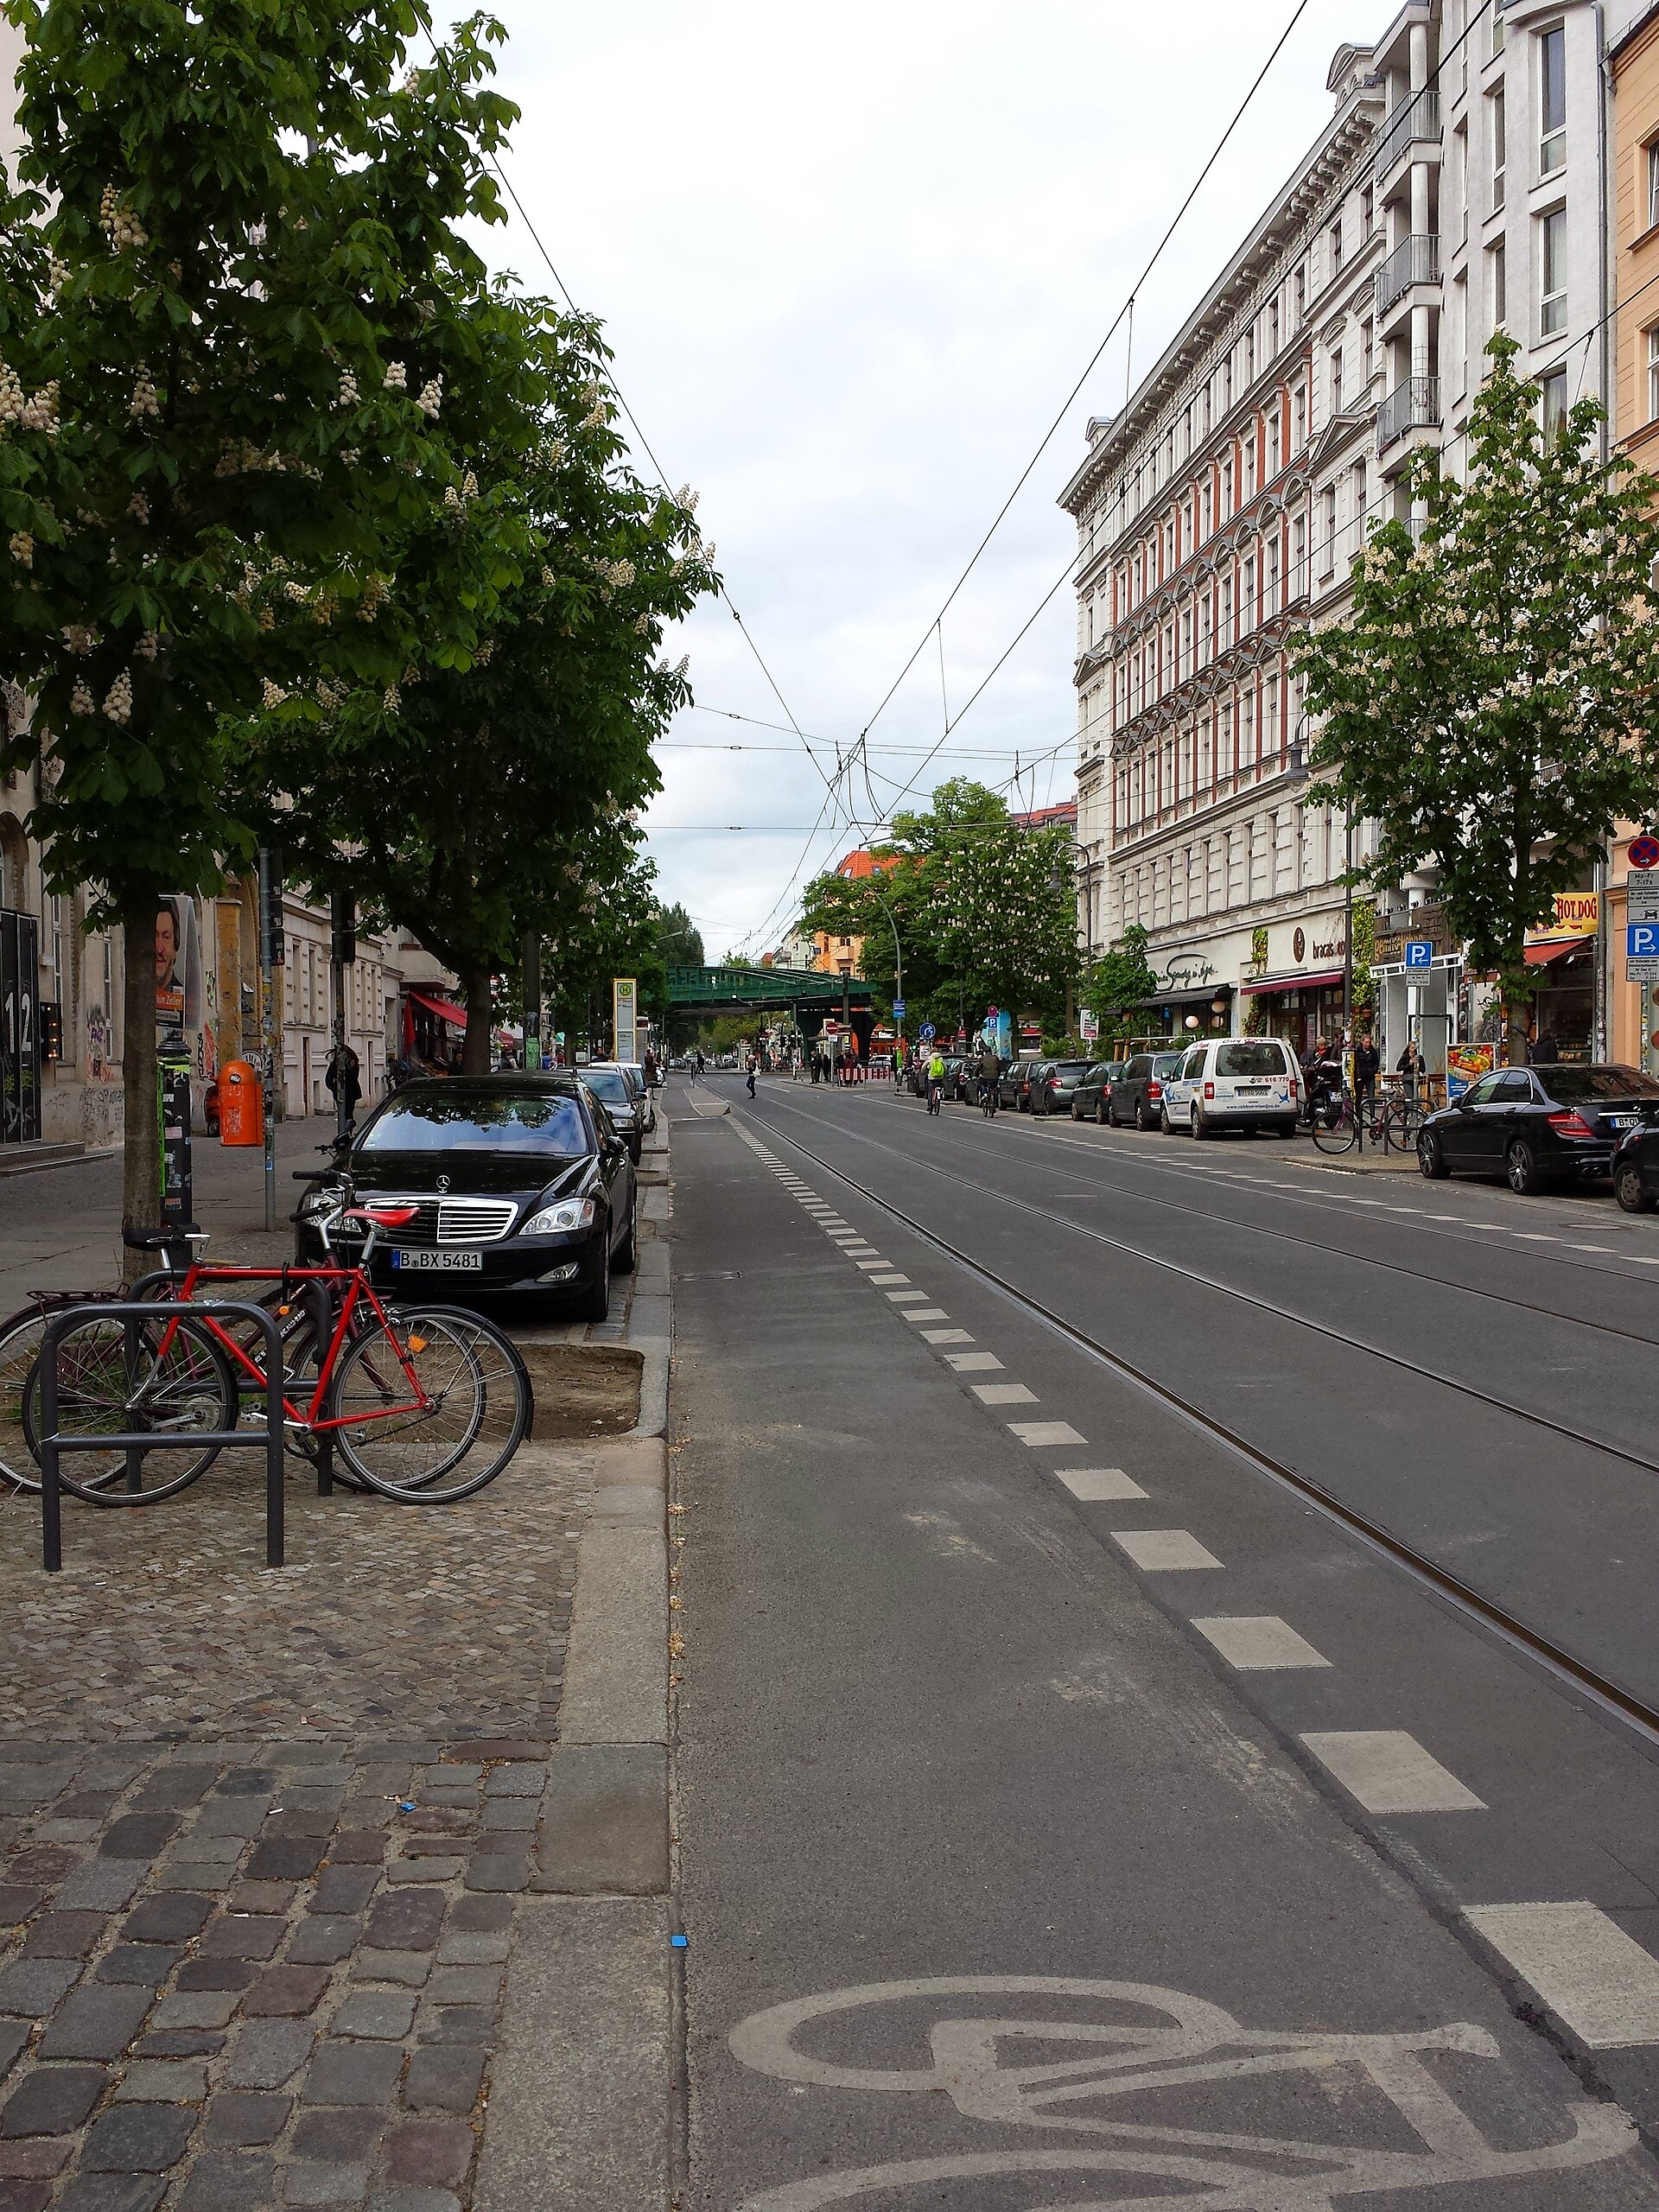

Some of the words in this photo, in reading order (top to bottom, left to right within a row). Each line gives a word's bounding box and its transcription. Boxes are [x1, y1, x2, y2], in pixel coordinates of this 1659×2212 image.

[1557, 897, 1575, 919] HOT
[1578, 897, 1598, 919] DOG
[1635, 928, 1653, 953] P
[1412, 945, 1426, 964] P
[166, 995, 181, 1007] Zeller
[5, 992, 31, 1053] 12
[1618, 1118, 1625, 1127] B
[401, 1253, 410, 1267] B
[420, 1253, 440, 1268] BX
[442, 1254, 480, 1268] 5481
